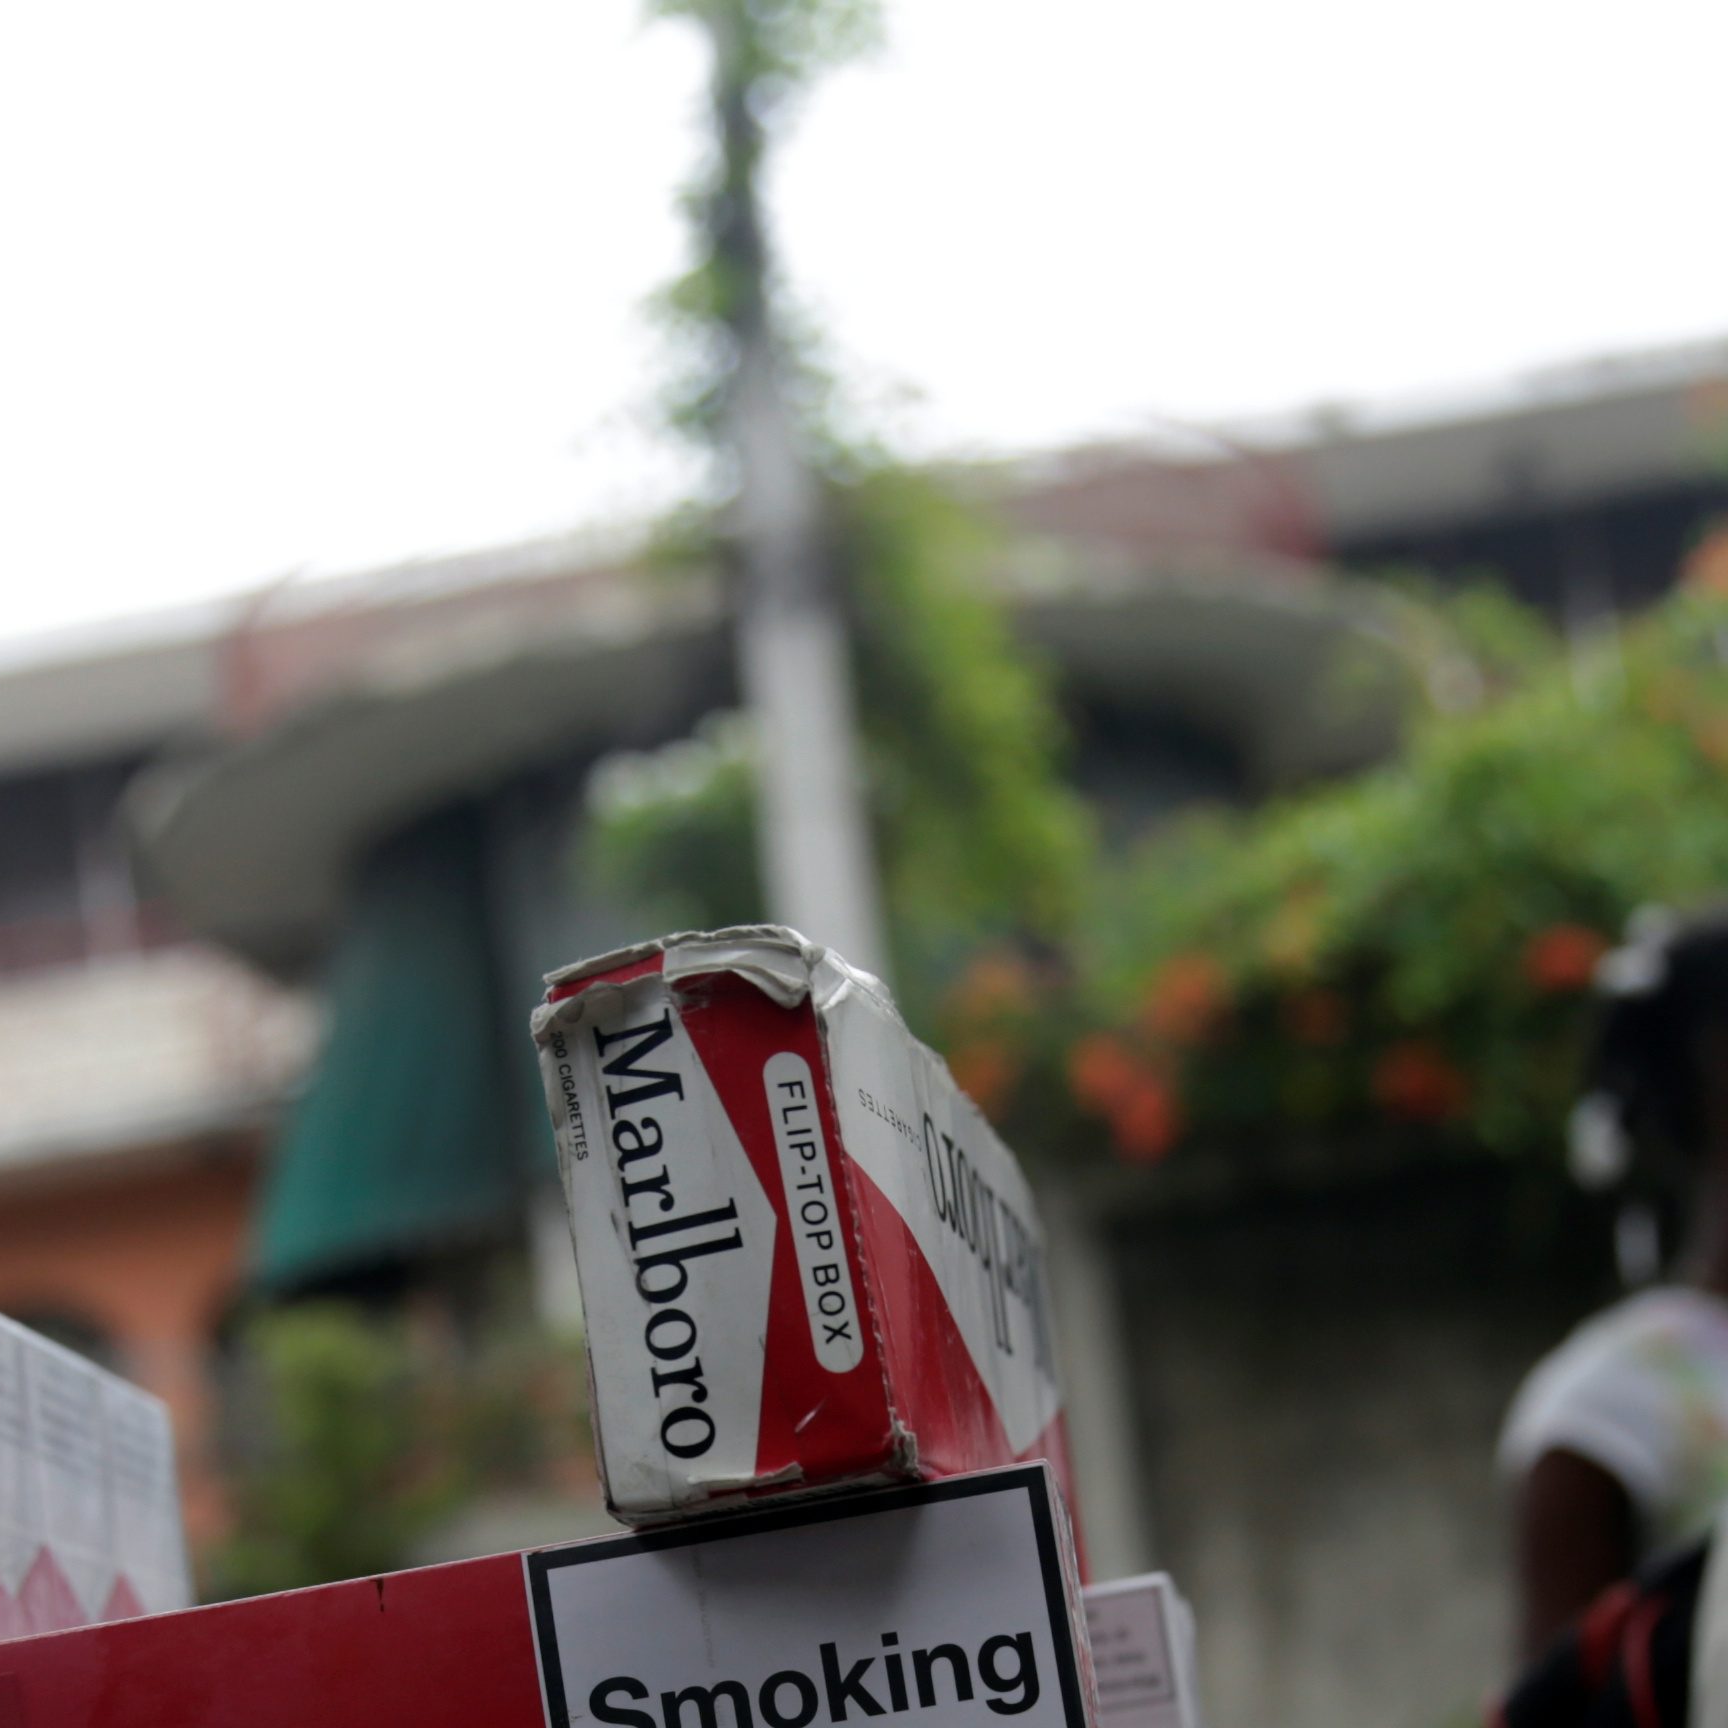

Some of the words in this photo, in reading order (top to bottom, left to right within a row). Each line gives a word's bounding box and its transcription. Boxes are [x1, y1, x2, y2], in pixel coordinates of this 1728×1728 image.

[559, 1064, 589, 1161] CIGARETTES
[592, 1008, 743, 1459] Marlboro
[776, 1079, 834, 1252] FLIP-TOP
[812, 1262, 853, 1345] BOX
